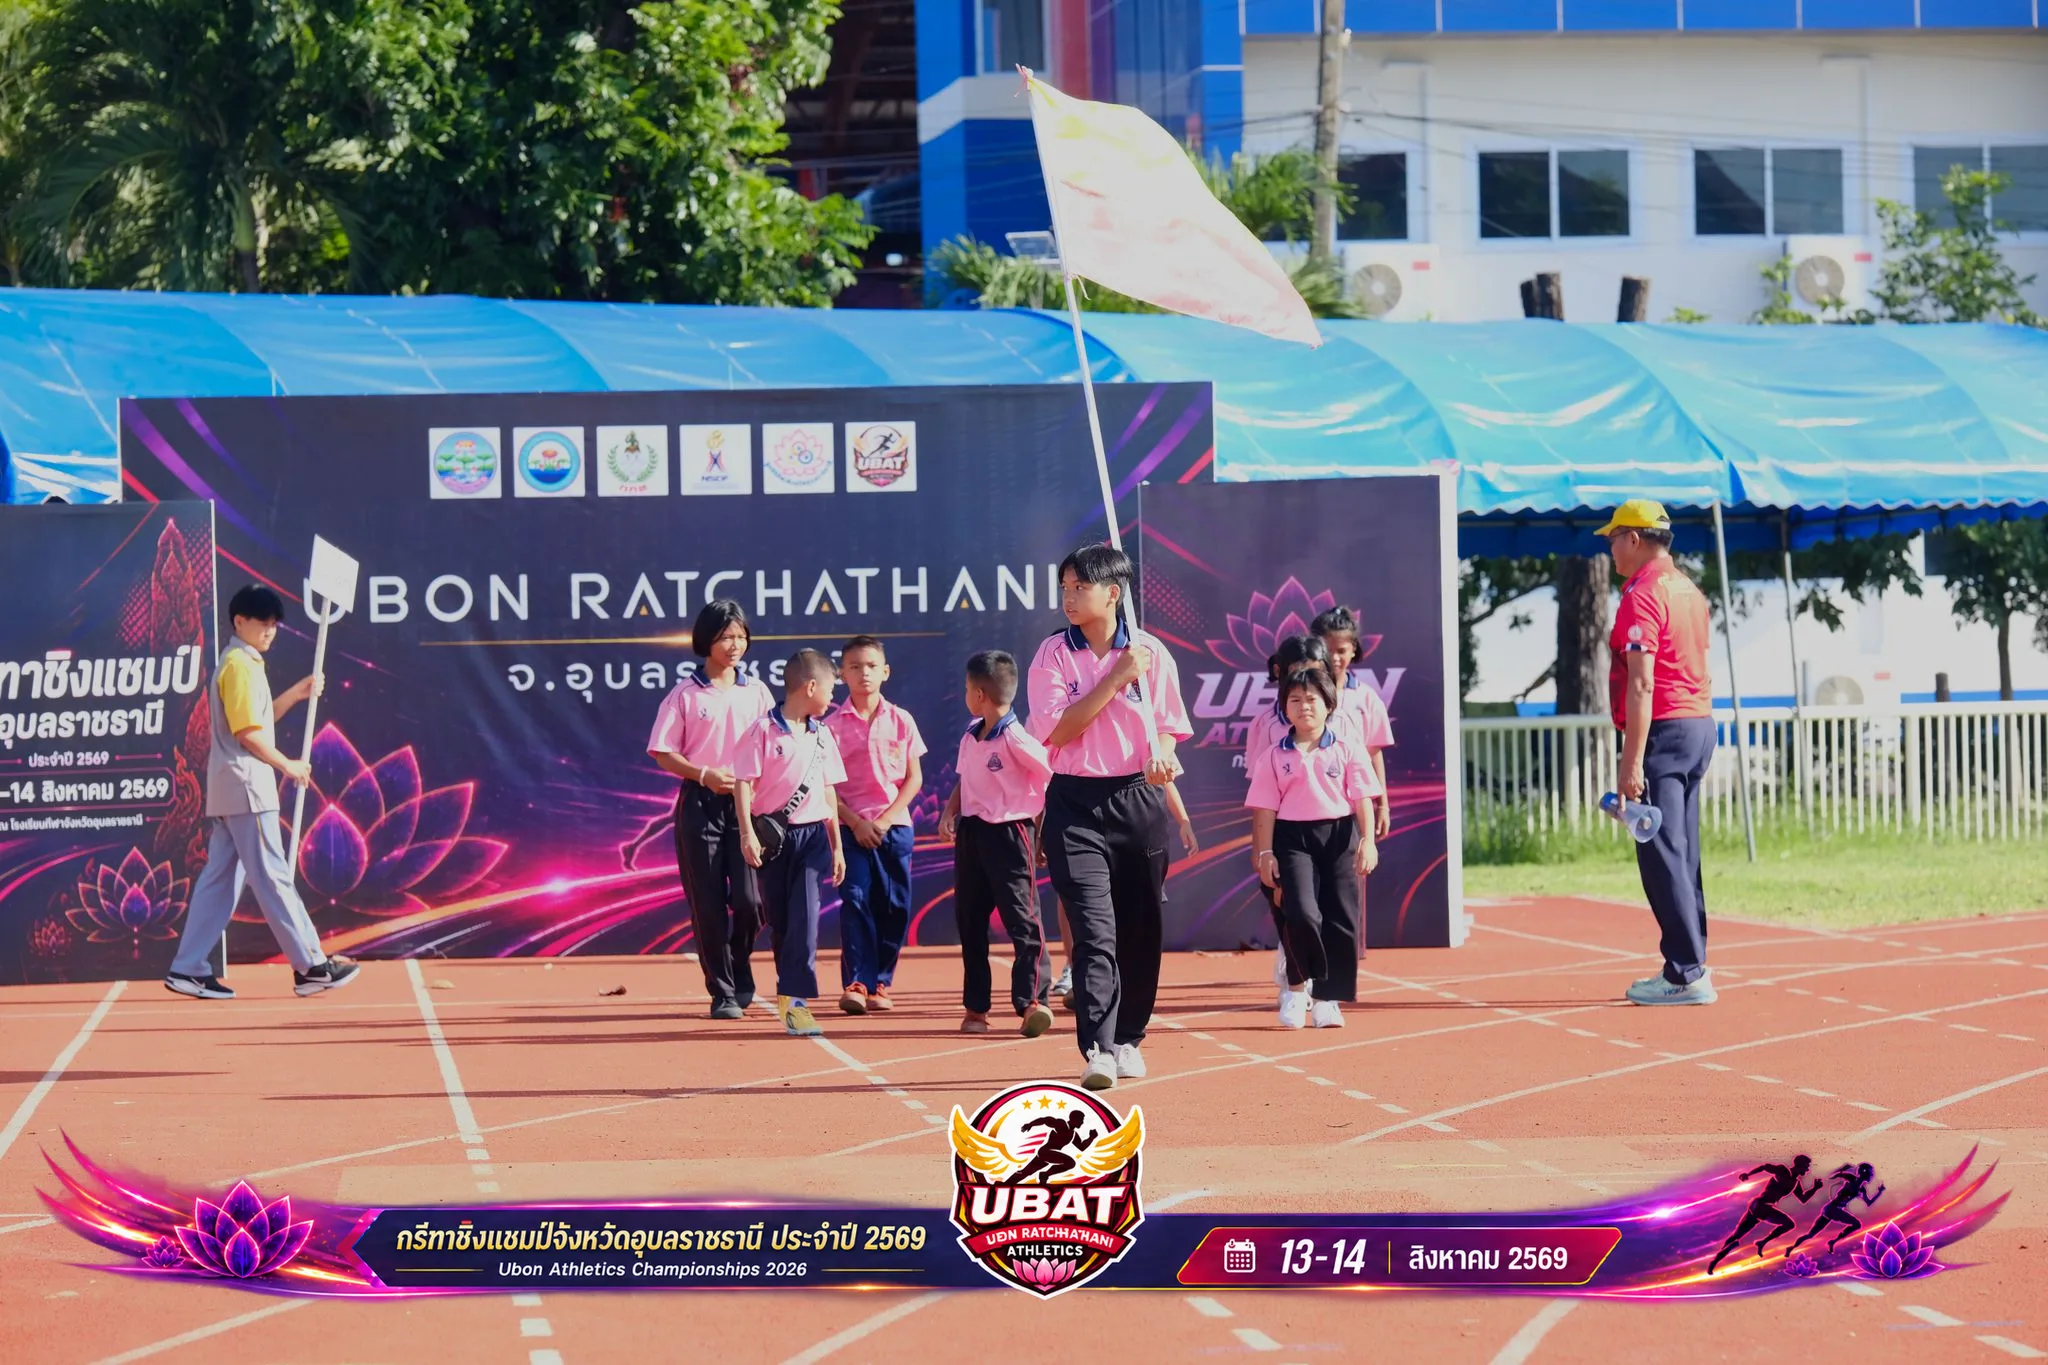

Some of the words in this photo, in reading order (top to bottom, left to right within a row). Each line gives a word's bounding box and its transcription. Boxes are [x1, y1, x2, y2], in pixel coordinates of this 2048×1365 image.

[570, 564, 1058, 620] RATCHATHANI
[1193, 667, 1407, 718] UBN
[77, 751, 109, 766] 2569
[42, 780, 114, 803] สิงหาคม
[120, 777, 169, 800] 2569
